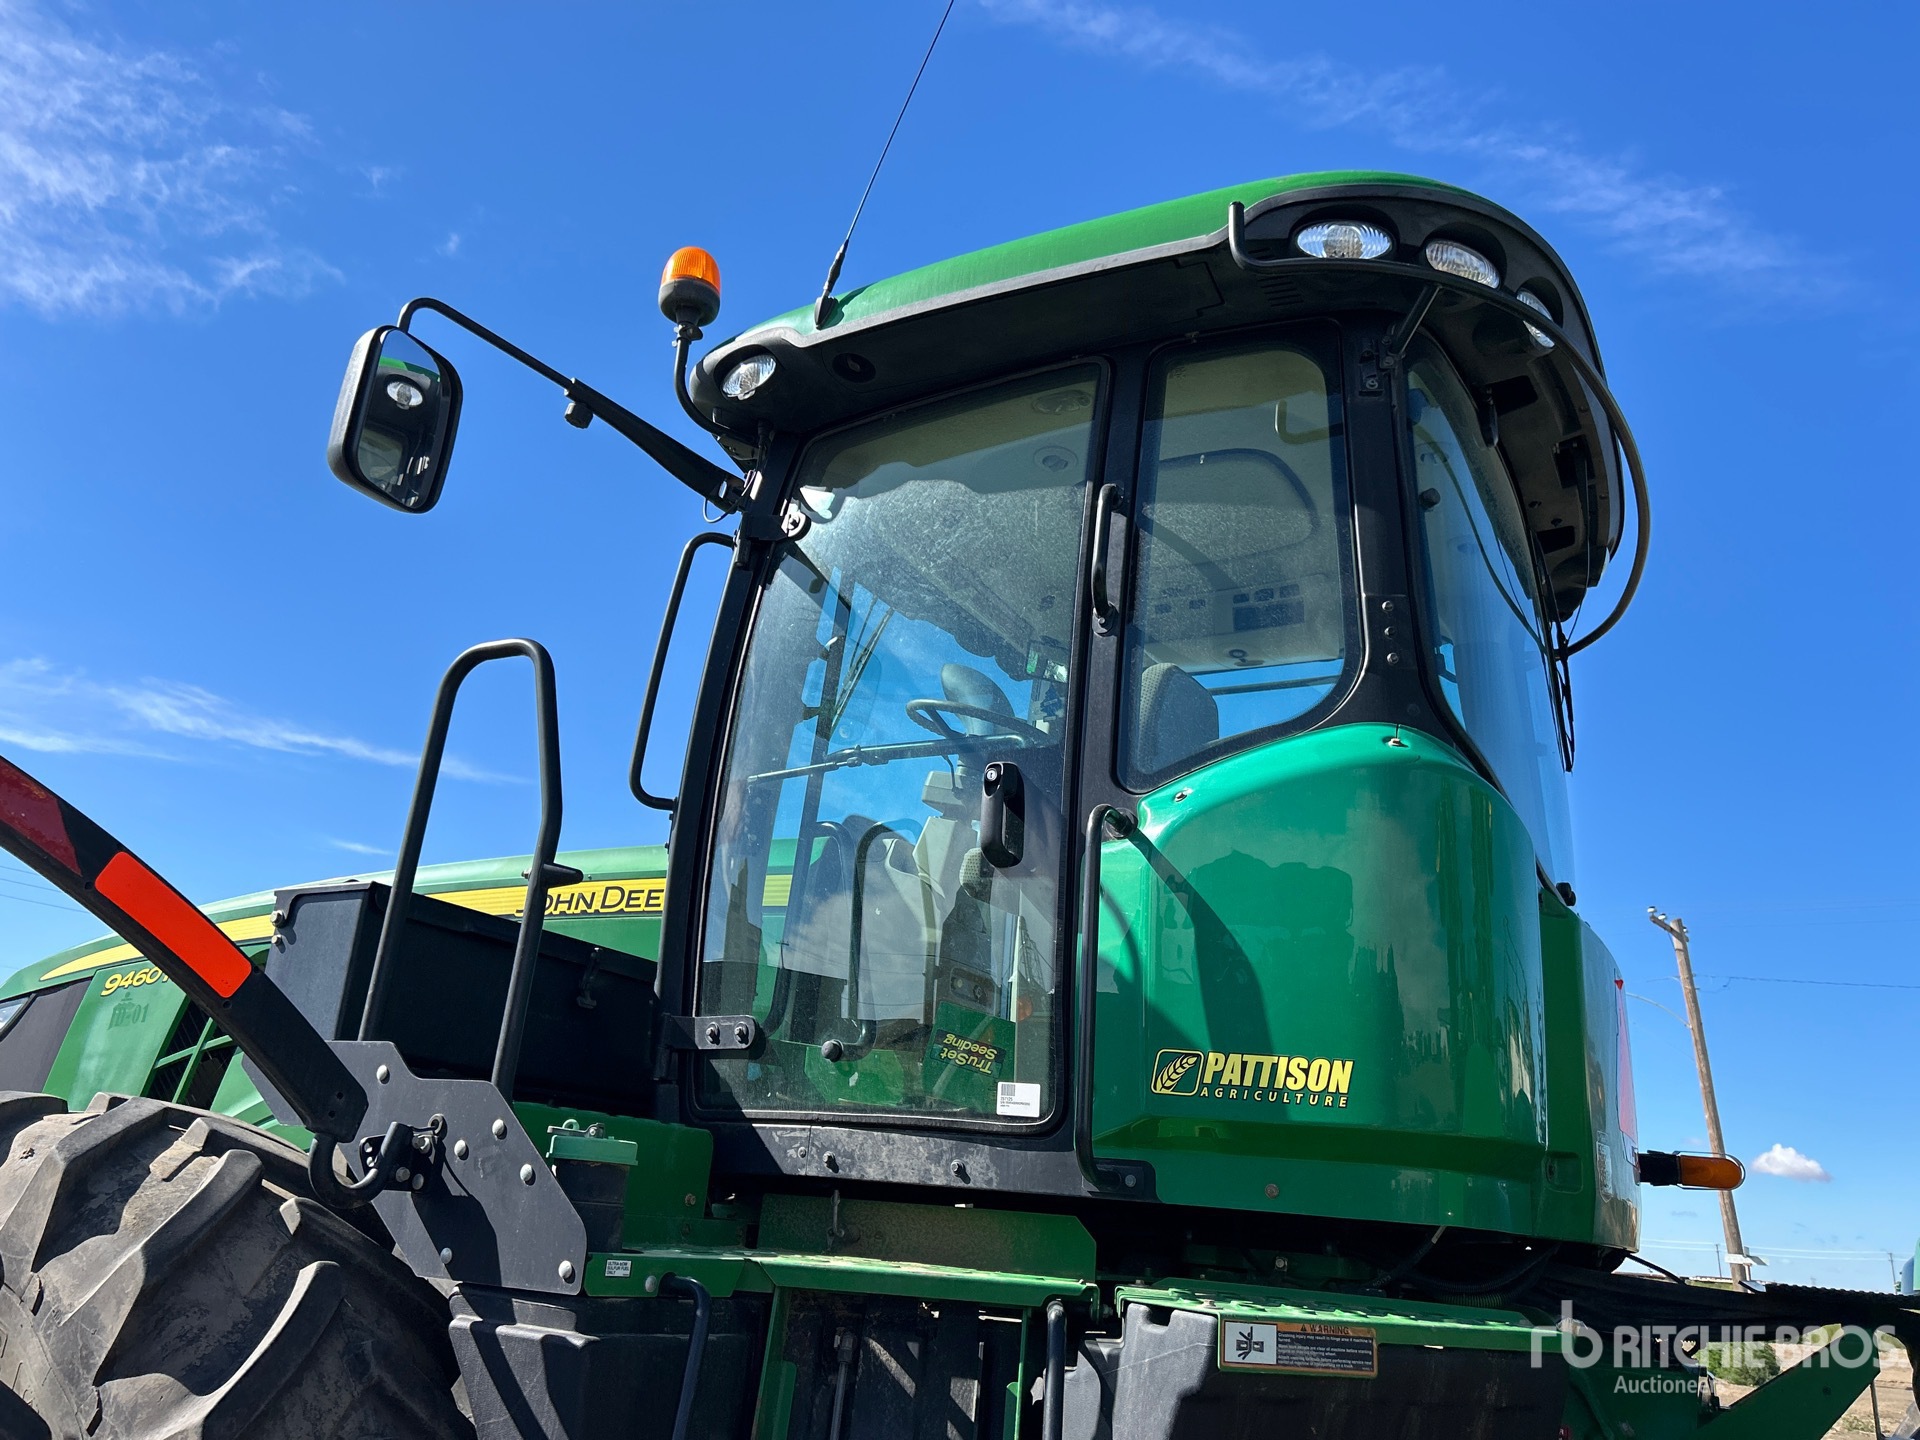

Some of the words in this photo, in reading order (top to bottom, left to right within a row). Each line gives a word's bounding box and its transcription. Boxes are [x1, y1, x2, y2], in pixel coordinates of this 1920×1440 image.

[600, 886, 665, 909] DEE
[100, 966, 169, 997] 9460
[943, 1033, 998, 1060] Seeding
[940, 1047, 992, 1074] TruSet
[1202, 1052, 1354, 1094] PATTISON
[1200, 1087, 1349, 1108] AGRICULTURE
[1310, 1323, 1350, 1335] WARNING
